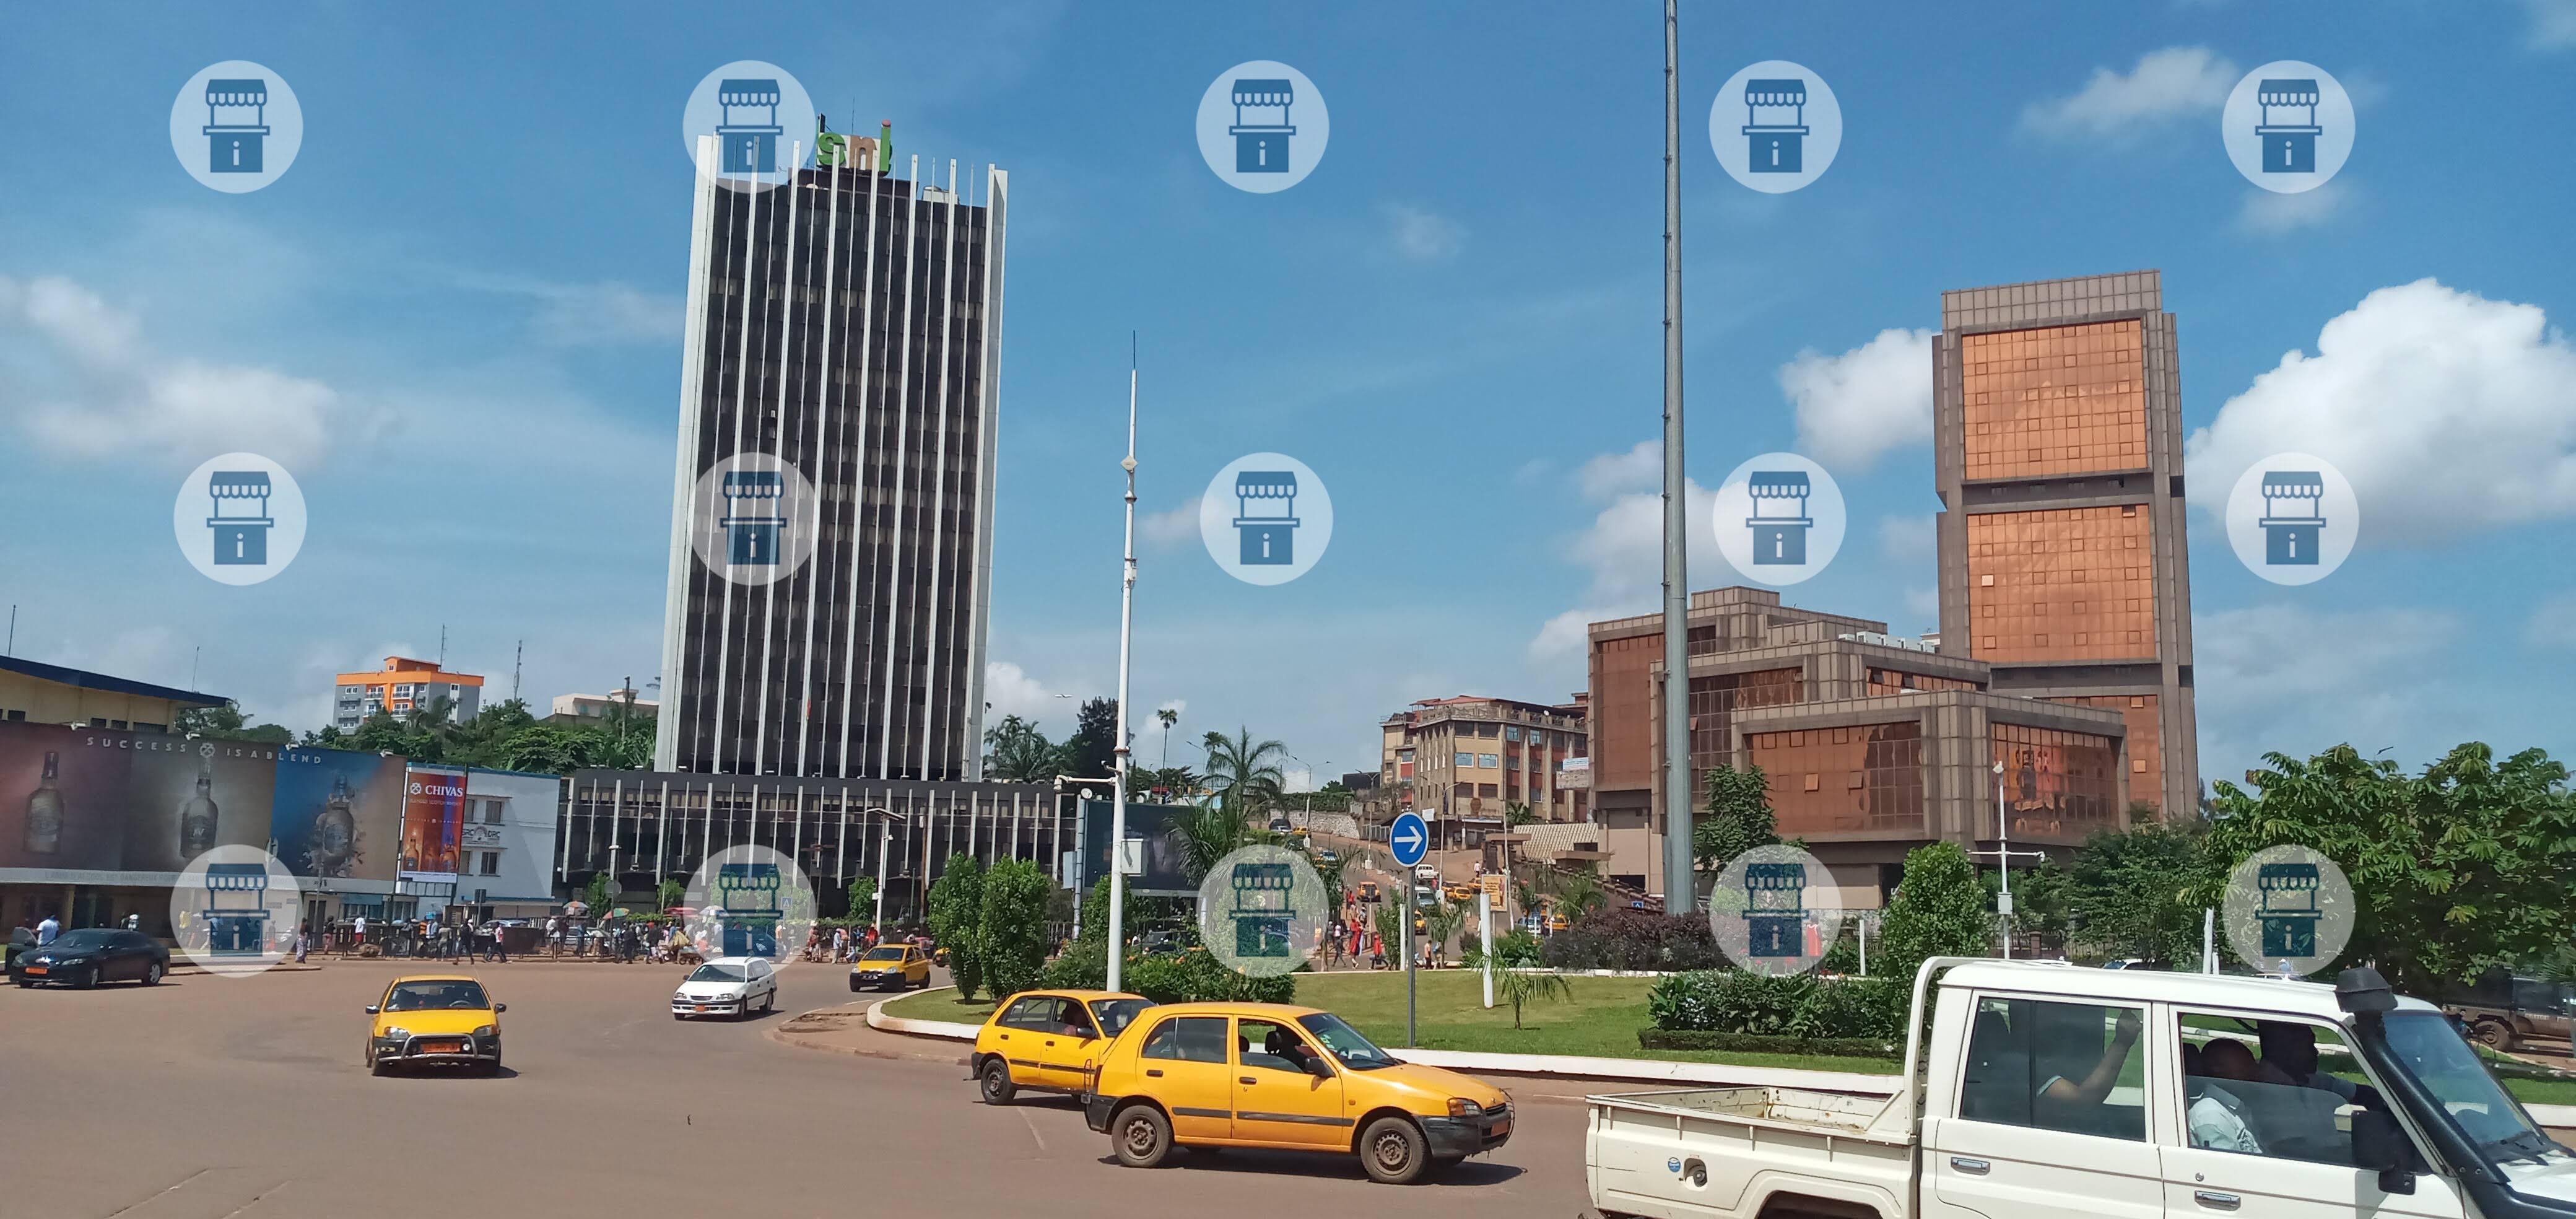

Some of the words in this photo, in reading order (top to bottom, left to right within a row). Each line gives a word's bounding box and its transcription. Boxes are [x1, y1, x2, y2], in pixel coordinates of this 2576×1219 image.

[87, 736, 186, 753] SUCCESS
[266, 751, 321, 764] BLEND
[425, 785, 463, 797] CHIVAS
